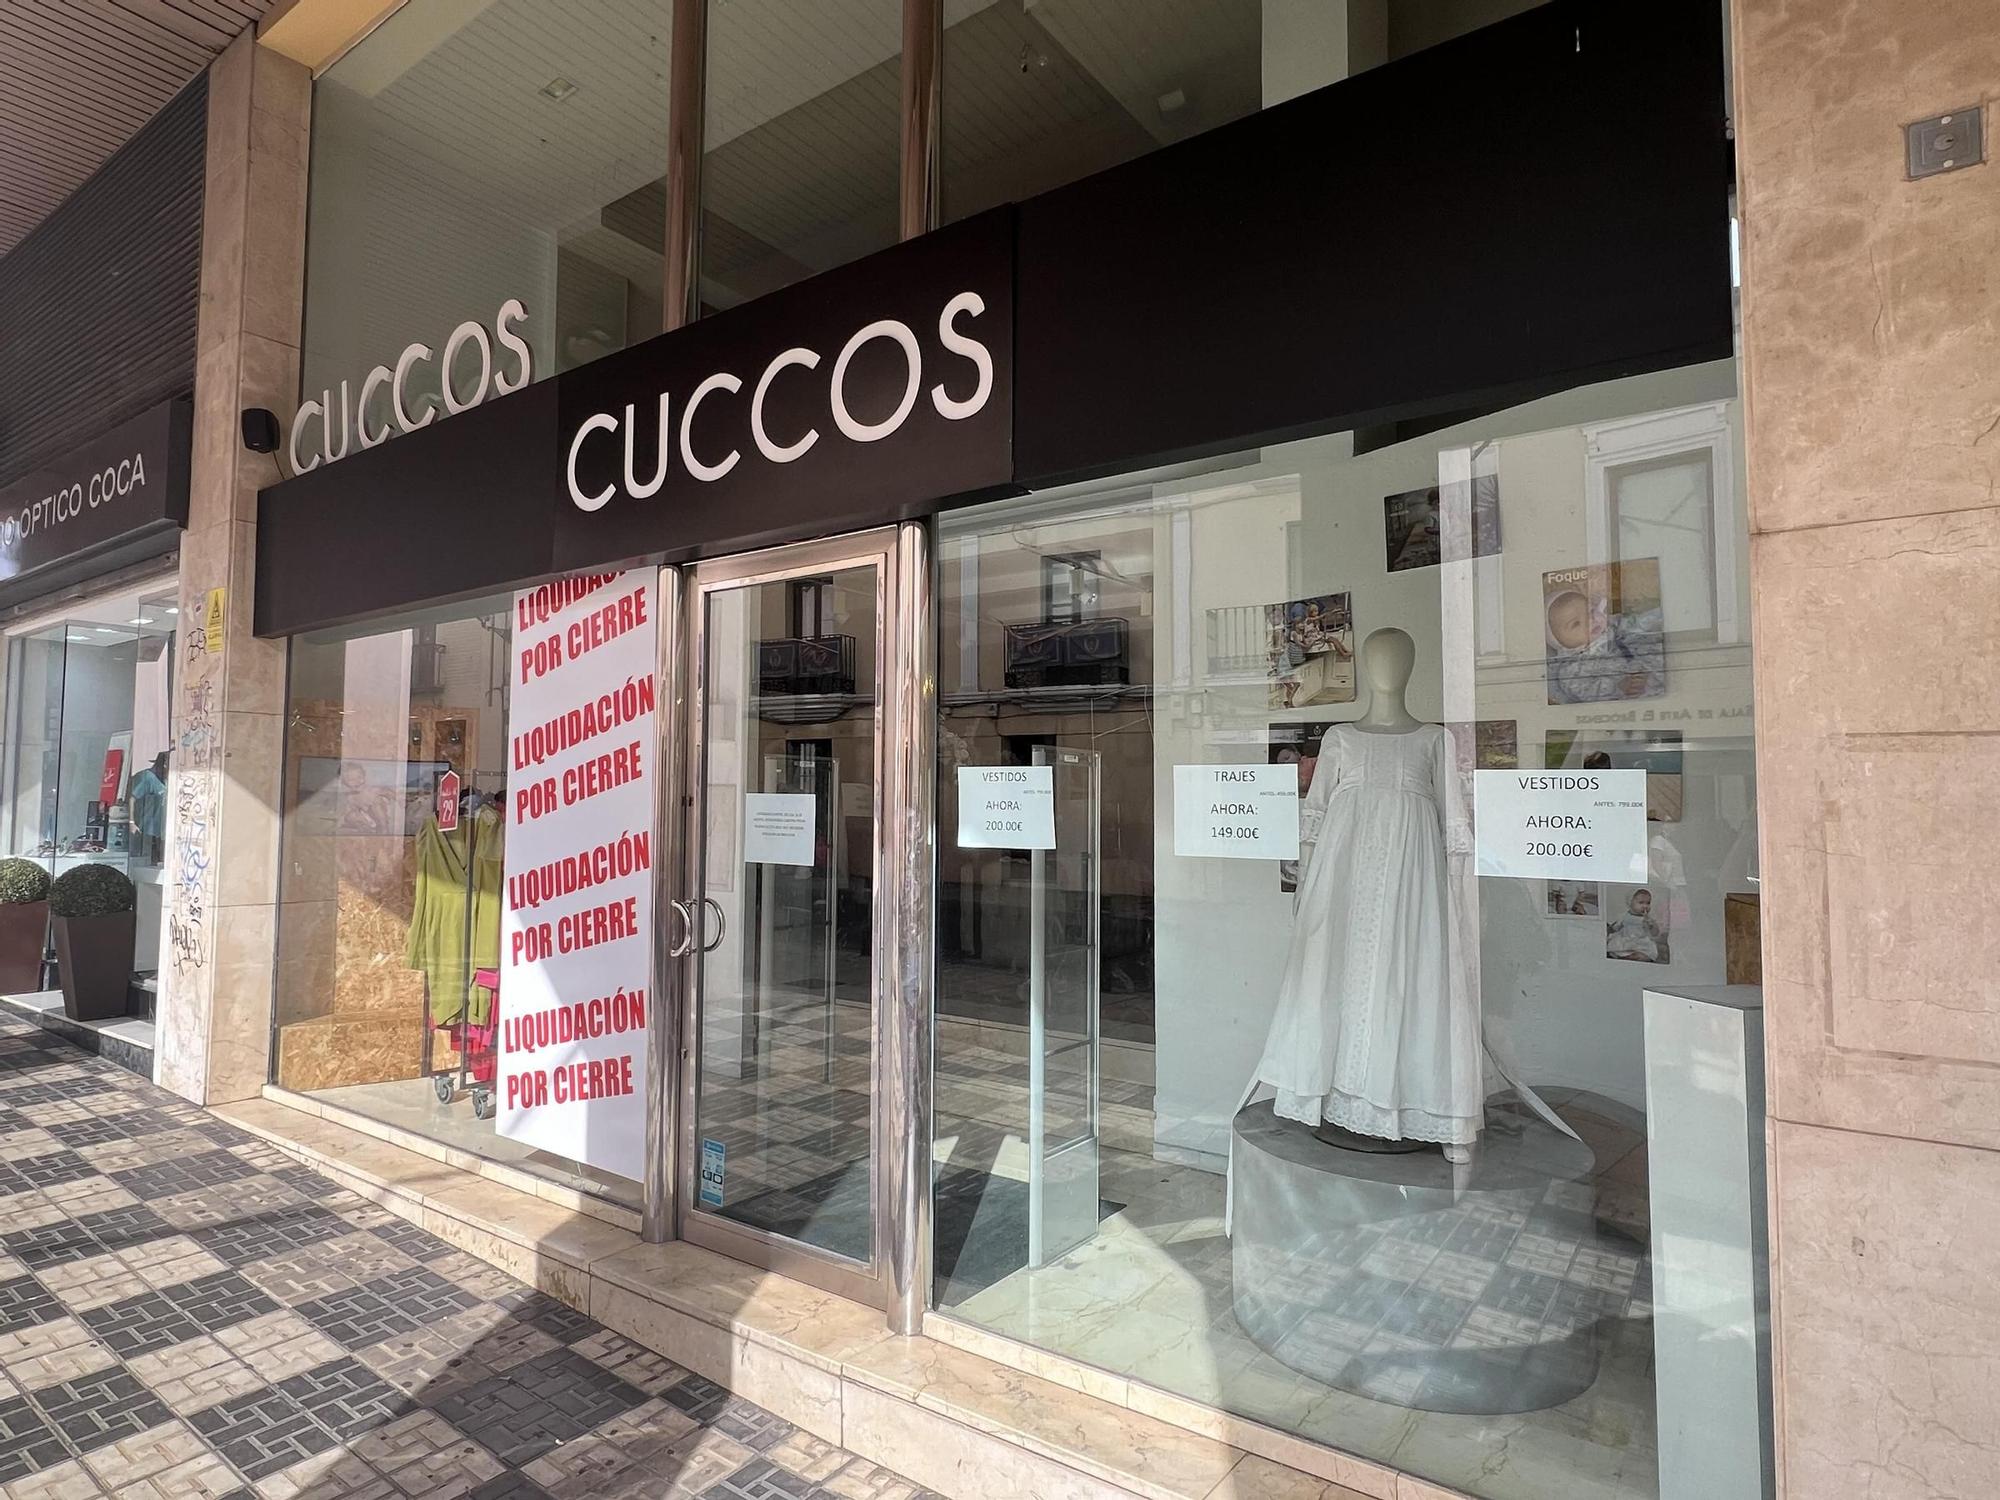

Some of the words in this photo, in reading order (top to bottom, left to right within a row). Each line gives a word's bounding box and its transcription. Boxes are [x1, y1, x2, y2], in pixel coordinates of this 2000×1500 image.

[289, 298, 530, 477] CUCCOS
[567, 291, 994, 512] CUCCOS
[0, 515, 15, 546] O
[89, 452, 146, 508] COCA
[1547, 569, 1589, 585] Foque
[521, 633, 562, 685] POR
[567, 586, 648, 661] CIERRE
[513, 673, 655, 771] LIQUIDACIÓN
[516, 777, 558, 825] POR
[562, 740, 642, 806] CIERRE
[981, 771, 1028, 782] VESTIDOS
[1213, 770, 1256, 782] TRAJES
[1518, 776, 1600, 790] VESTIDOS
[985, 800, 1022, 811] AHORA:
[1210, 803, 1259, 815] AHORA:
[1526, 815, 1592, 830] AHORA:
[985, 820, 1024, 832] 200.00€
[1211, 826, 1260, 839] 149.00€
[1526, 842, 1593, 858] 200.00€
[508, 829, 650, 911] LIQUIDACIÓN
[512, 922, 553, 967] POR
[557, 896, 638, 954] CIERRE
[504, 986, 646, 1054] LIQUIDACIÓN
[507, 1069, 548, 1111] POR
[553, 1055, 634, 1104] CIERRE
